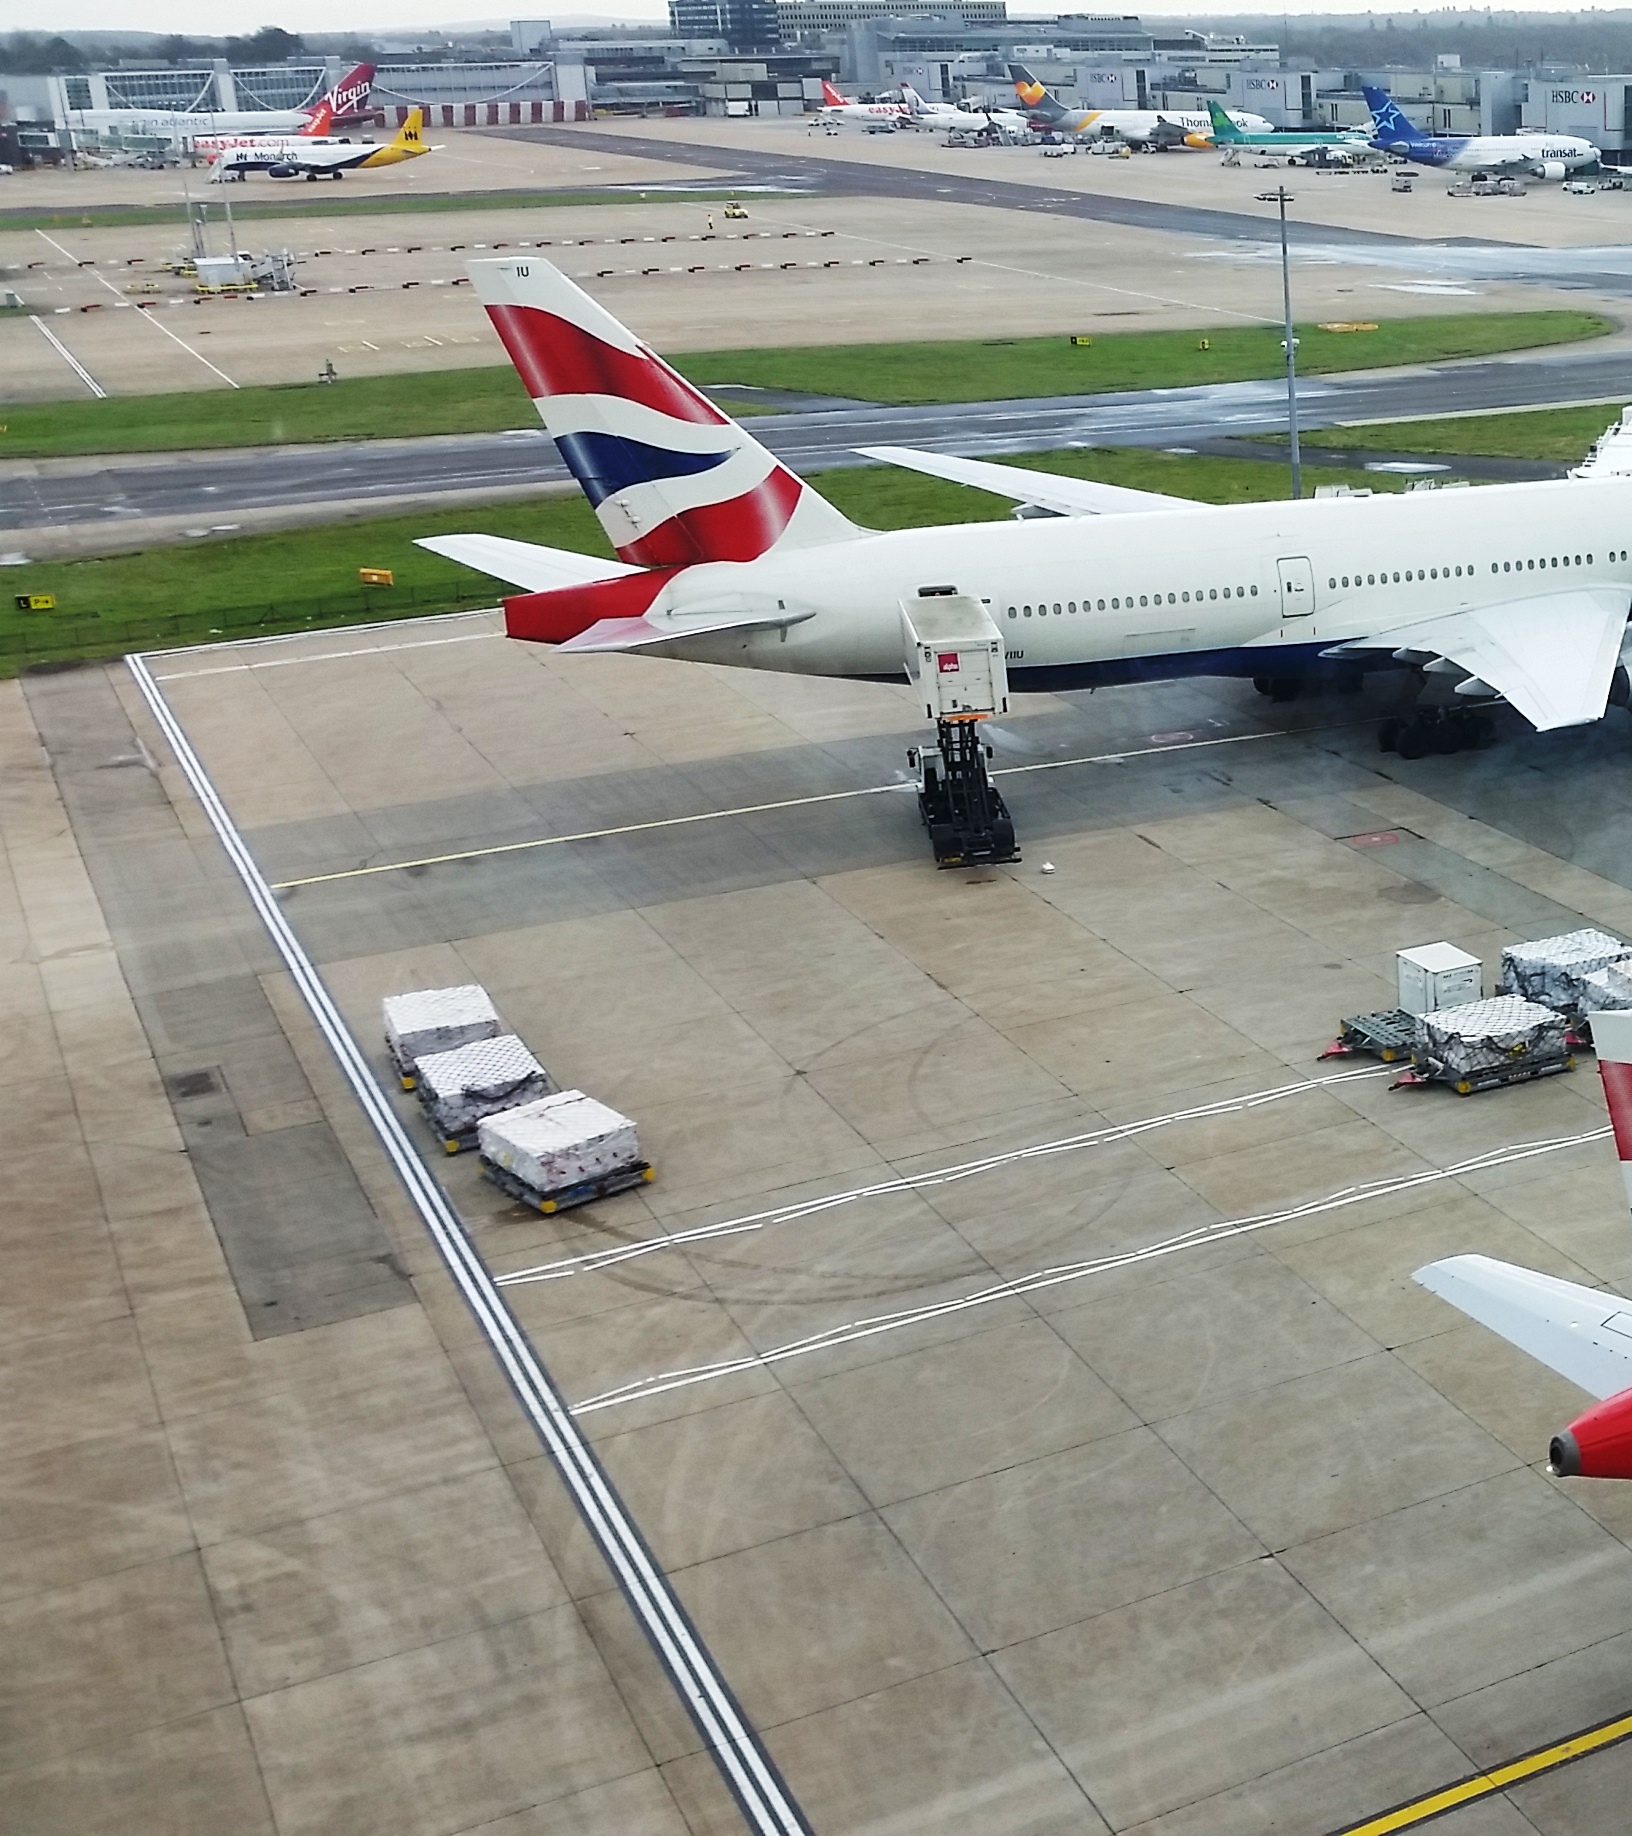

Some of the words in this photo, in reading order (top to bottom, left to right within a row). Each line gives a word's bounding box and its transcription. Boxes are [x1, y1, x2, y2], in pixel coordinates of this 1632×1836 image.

[324, 81, 370, 115] Virgin
[1552, 90, 1579, 104] HSBC
[254, 152, 297, 161] Monrch
[516, 266, 529, 277] IU
